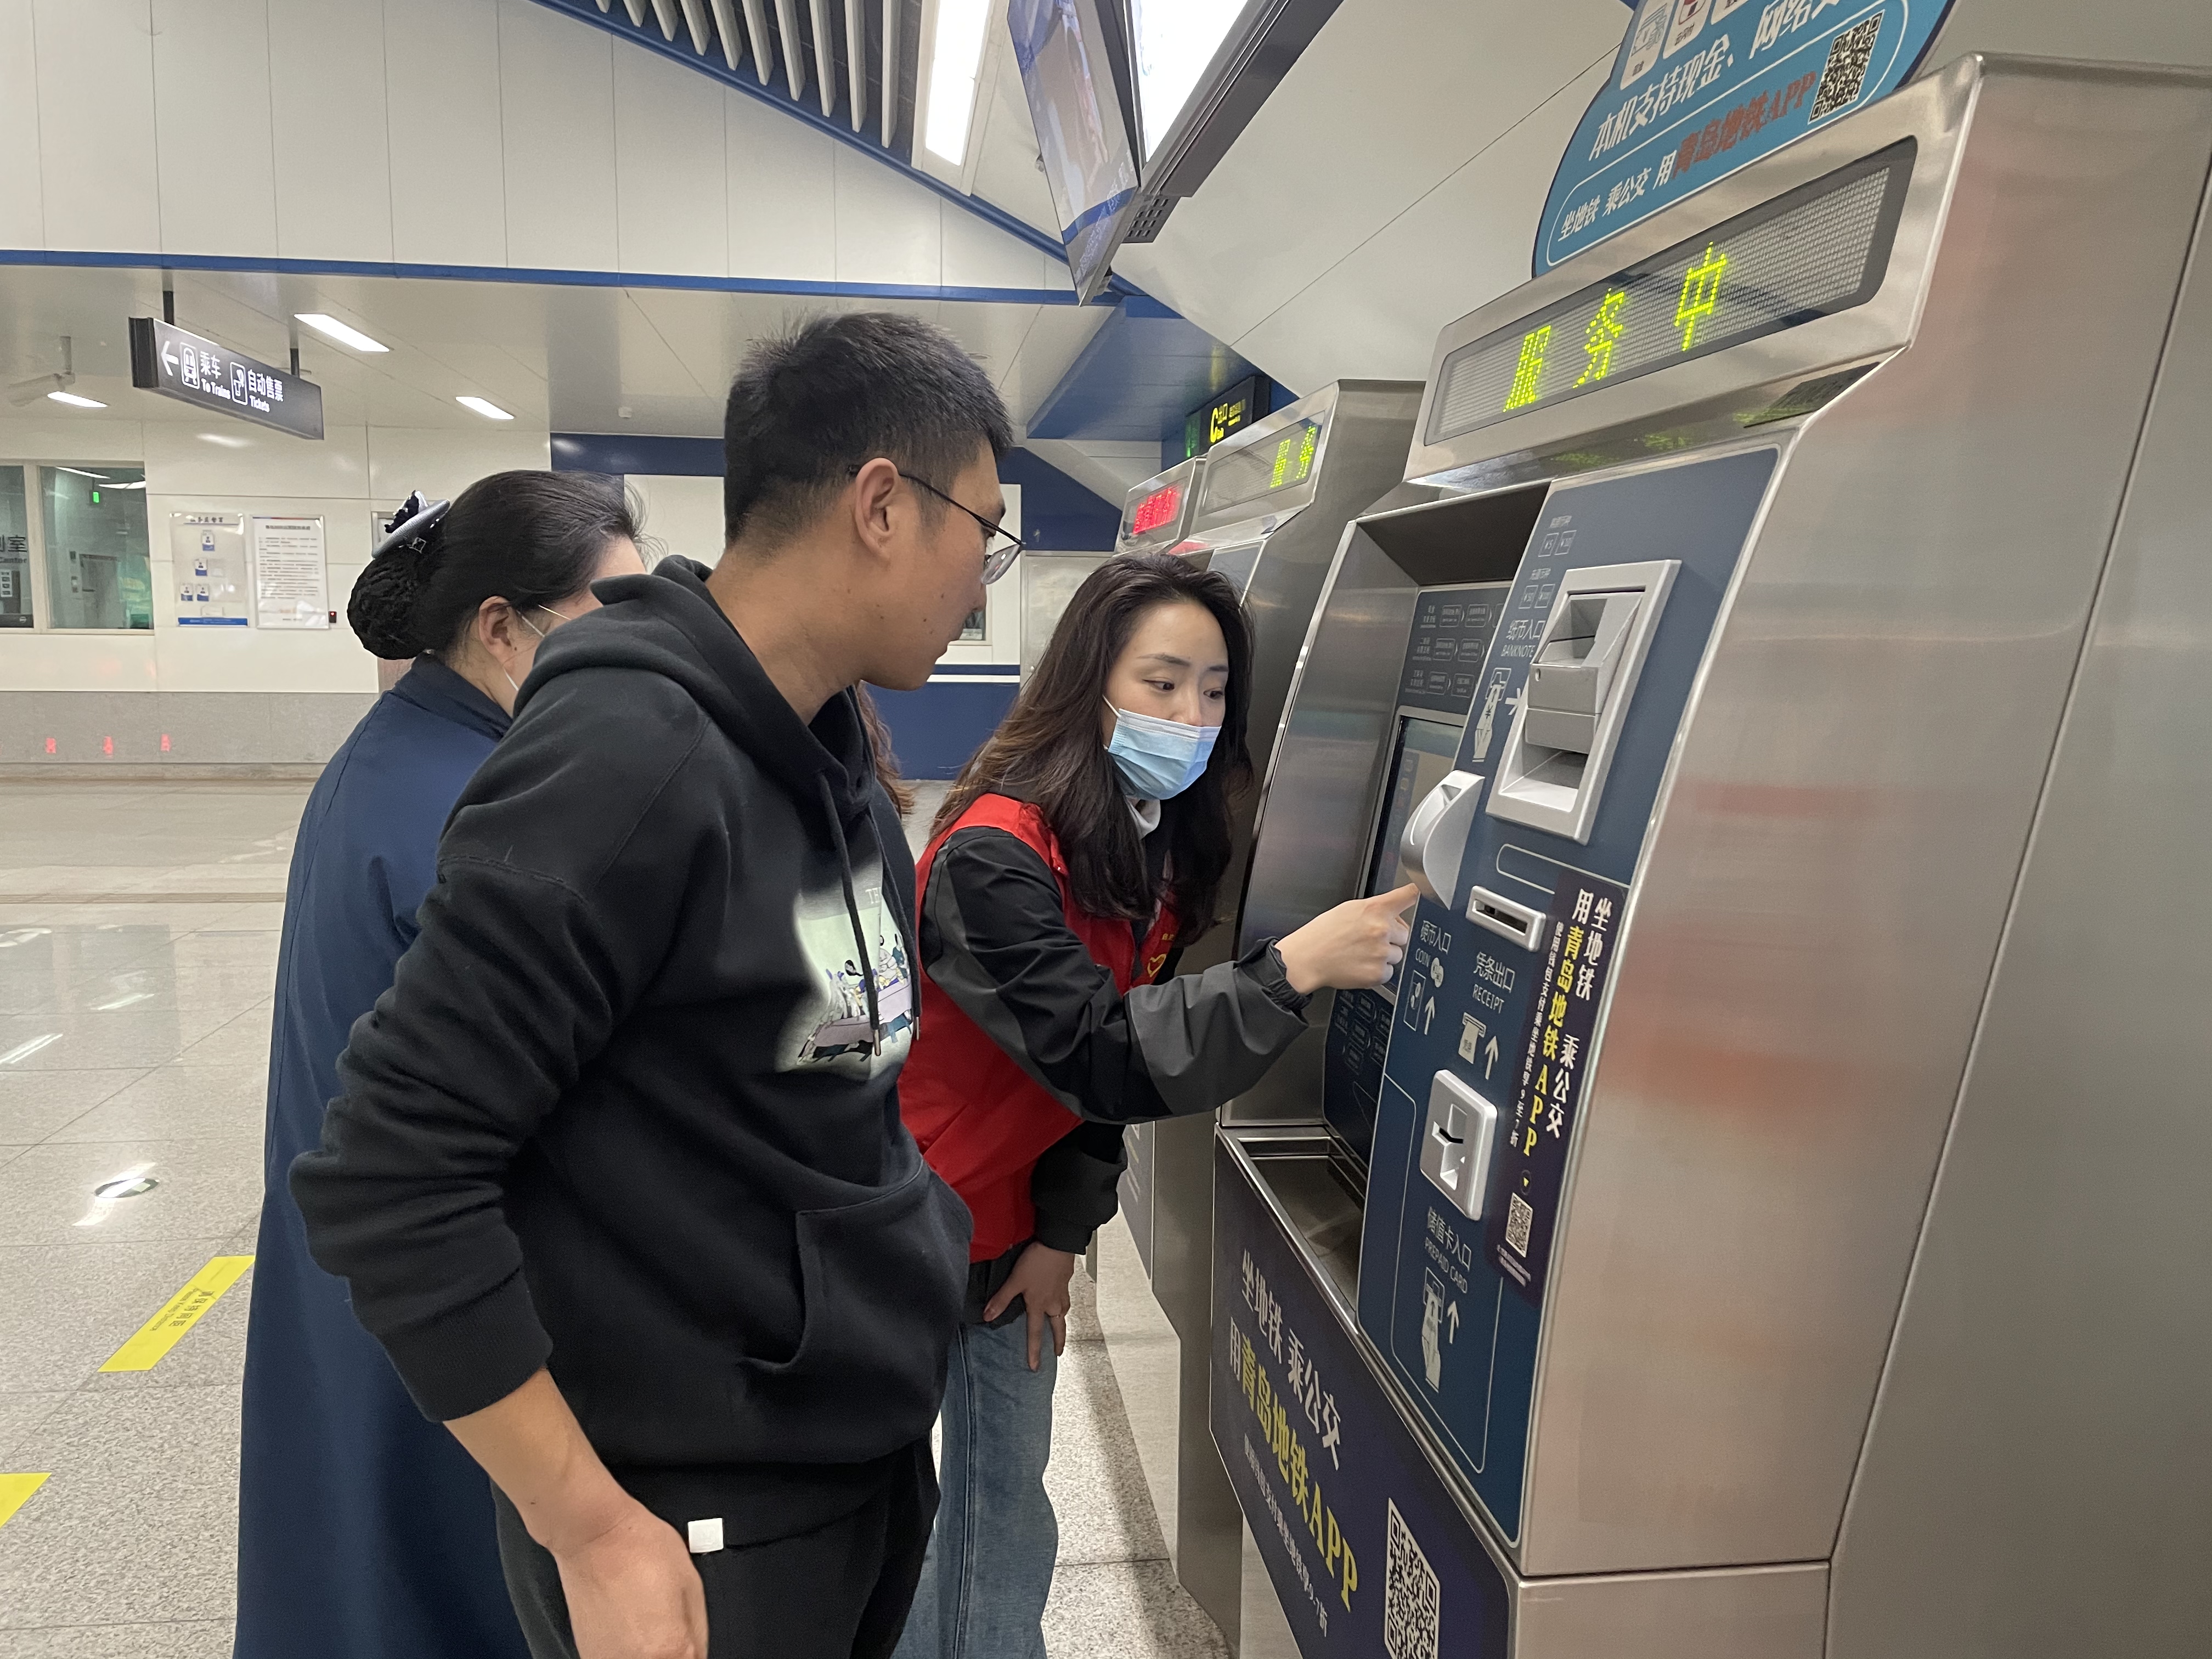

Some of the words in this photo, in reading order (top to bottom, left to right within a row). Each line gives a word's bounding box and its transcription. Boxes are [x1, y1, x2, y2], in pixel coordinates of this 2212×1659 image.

[1558, 195, 1600, 241] 坐地铁
[1602, 167, 1651, 217] 乘公交
[1503, 241, 1728, 412] 服务中
[200, 351, 222, 379] 乘车
[248, 369, 284, 402] 自动售票
[201, 378, 211, 393] To
[211, 381, 231, 399] Trains
[250, 395, 270, 412] Tickets
[1501, 644, 1536, 658] BANKNOTE
[1506, 619, 1545, 641] 纸币入口
[1415, 947, 1431, 968] COIN
[1420, 920, 1452, 955] 硬币入口
[1575, 896, 1613, 1002] 坐地铁
[1473, 951, 1515, 993] 凭条出口
[1472, 984, 1505, 1014] RECEIPT
[1545, 1034, 1580, 1139] 乘公交
[1427, 1206, 1472, 1272] 储值卡入口
[1450, 1265, 1468, 1294] CARD
[1242, 1248, 1283, 1364] 坐地铁
[1288, 1328, 1341, 1471] 乘公交
[1229, 1316, 1358, 1613] 用青岛地铁APP
